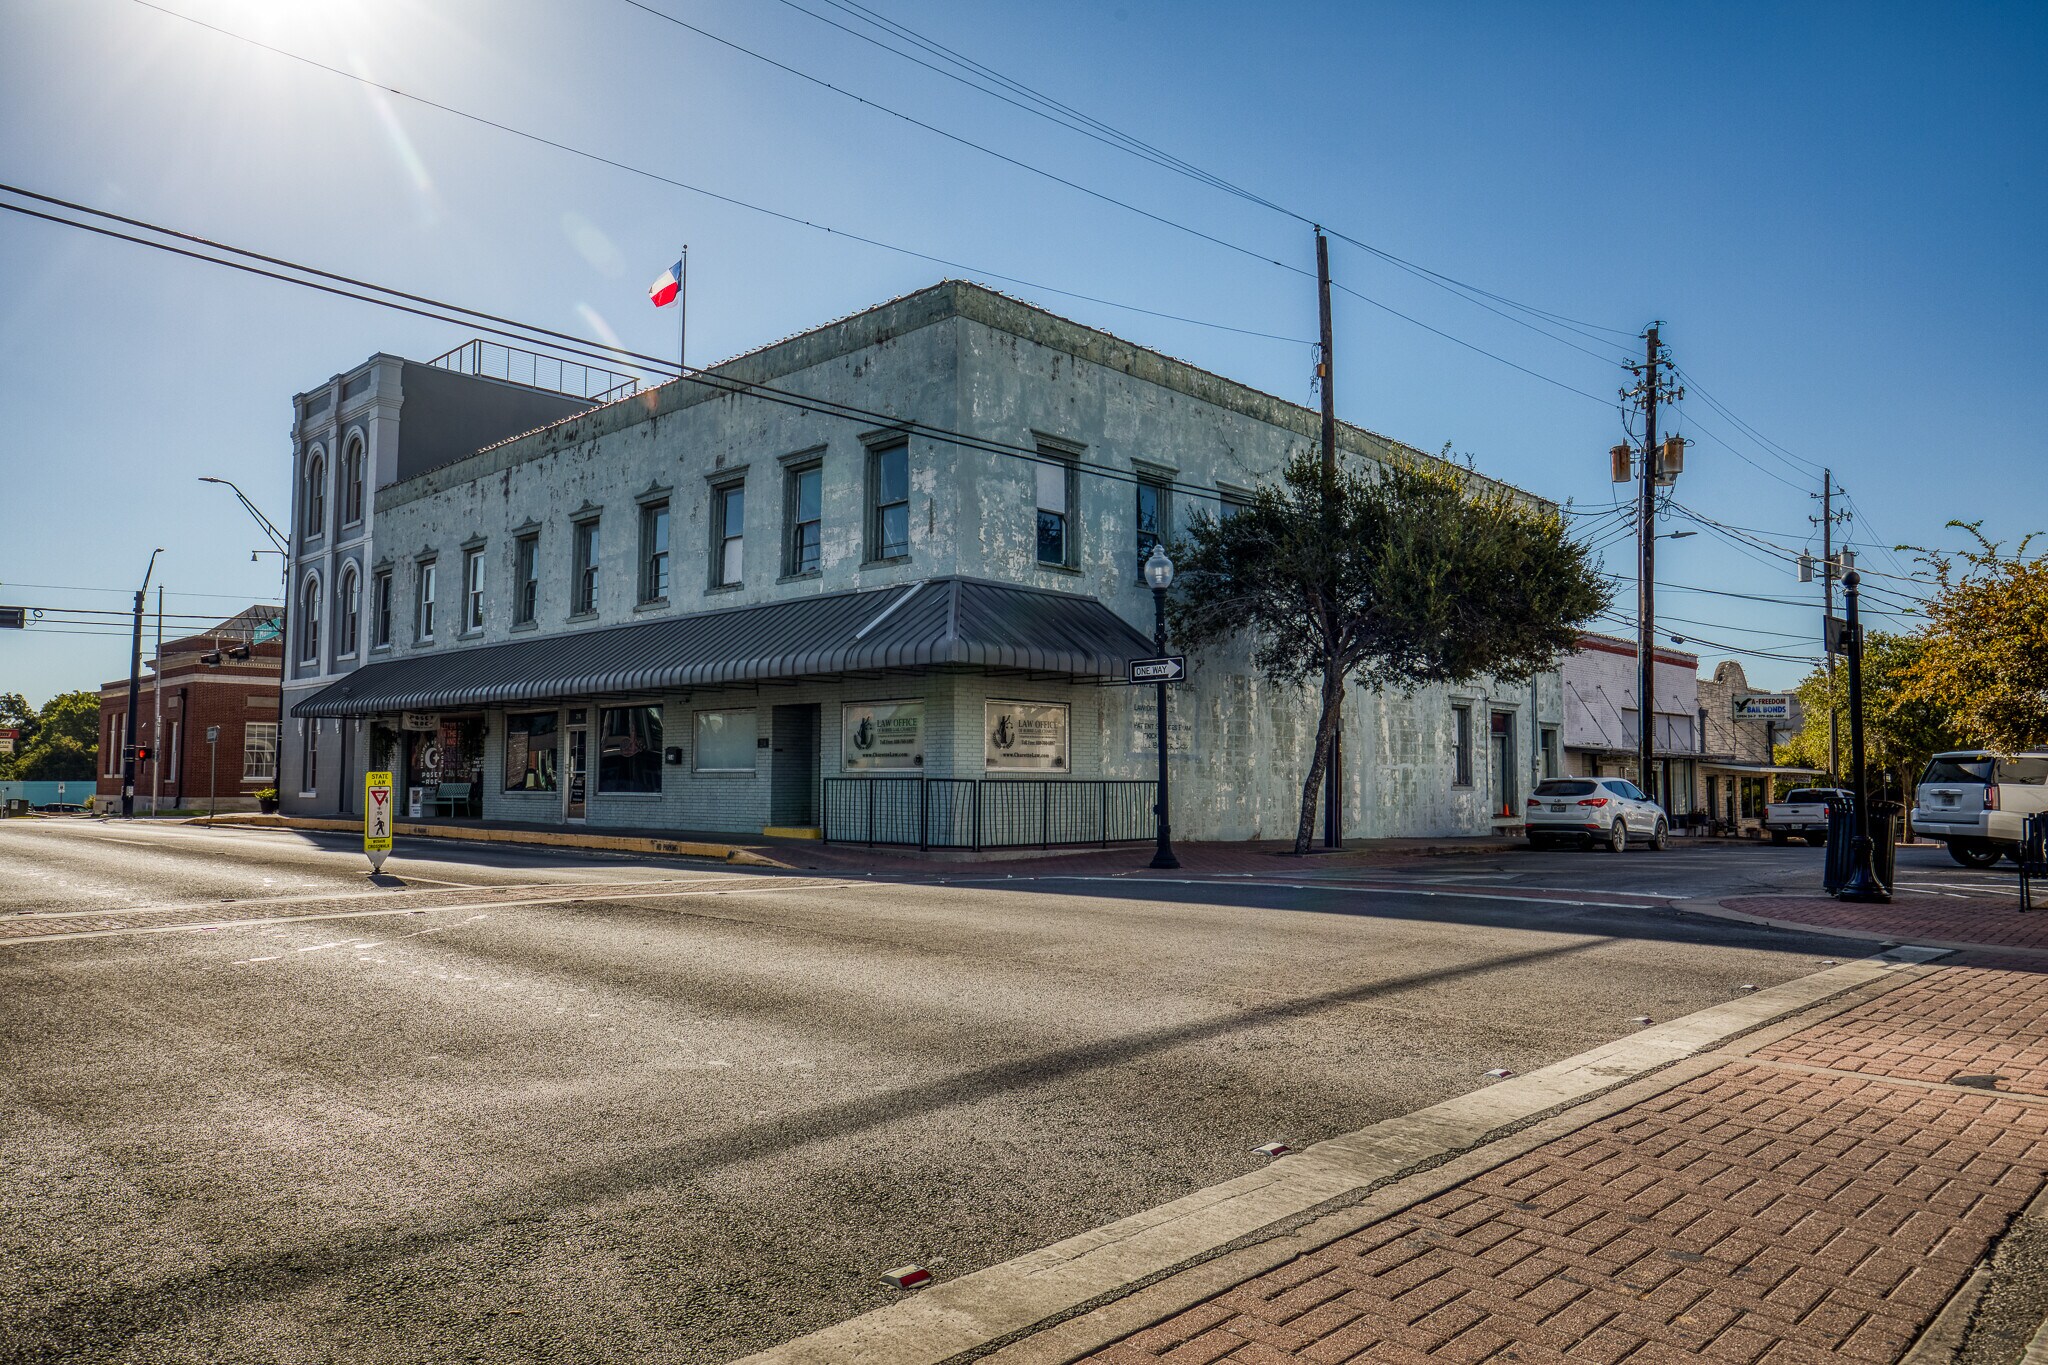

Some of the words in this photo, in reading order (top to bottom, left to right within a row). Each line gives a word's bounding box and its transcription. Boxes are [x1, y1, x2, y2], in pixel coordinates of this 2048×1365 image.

[1136, 667, 1150, 675] ONE
[1152, 665, 1167, 674] WAY
[1746, 705, 1762, 713] BAIL
[1762, 705, 1786, 713] BONDS
[877, 719, 892, 727] LAW
[893, 717, 918, 727] OFFICE
[1018, 720, 1034, 728] LAW
[1034, 720, 1058, 729] OFFICE
